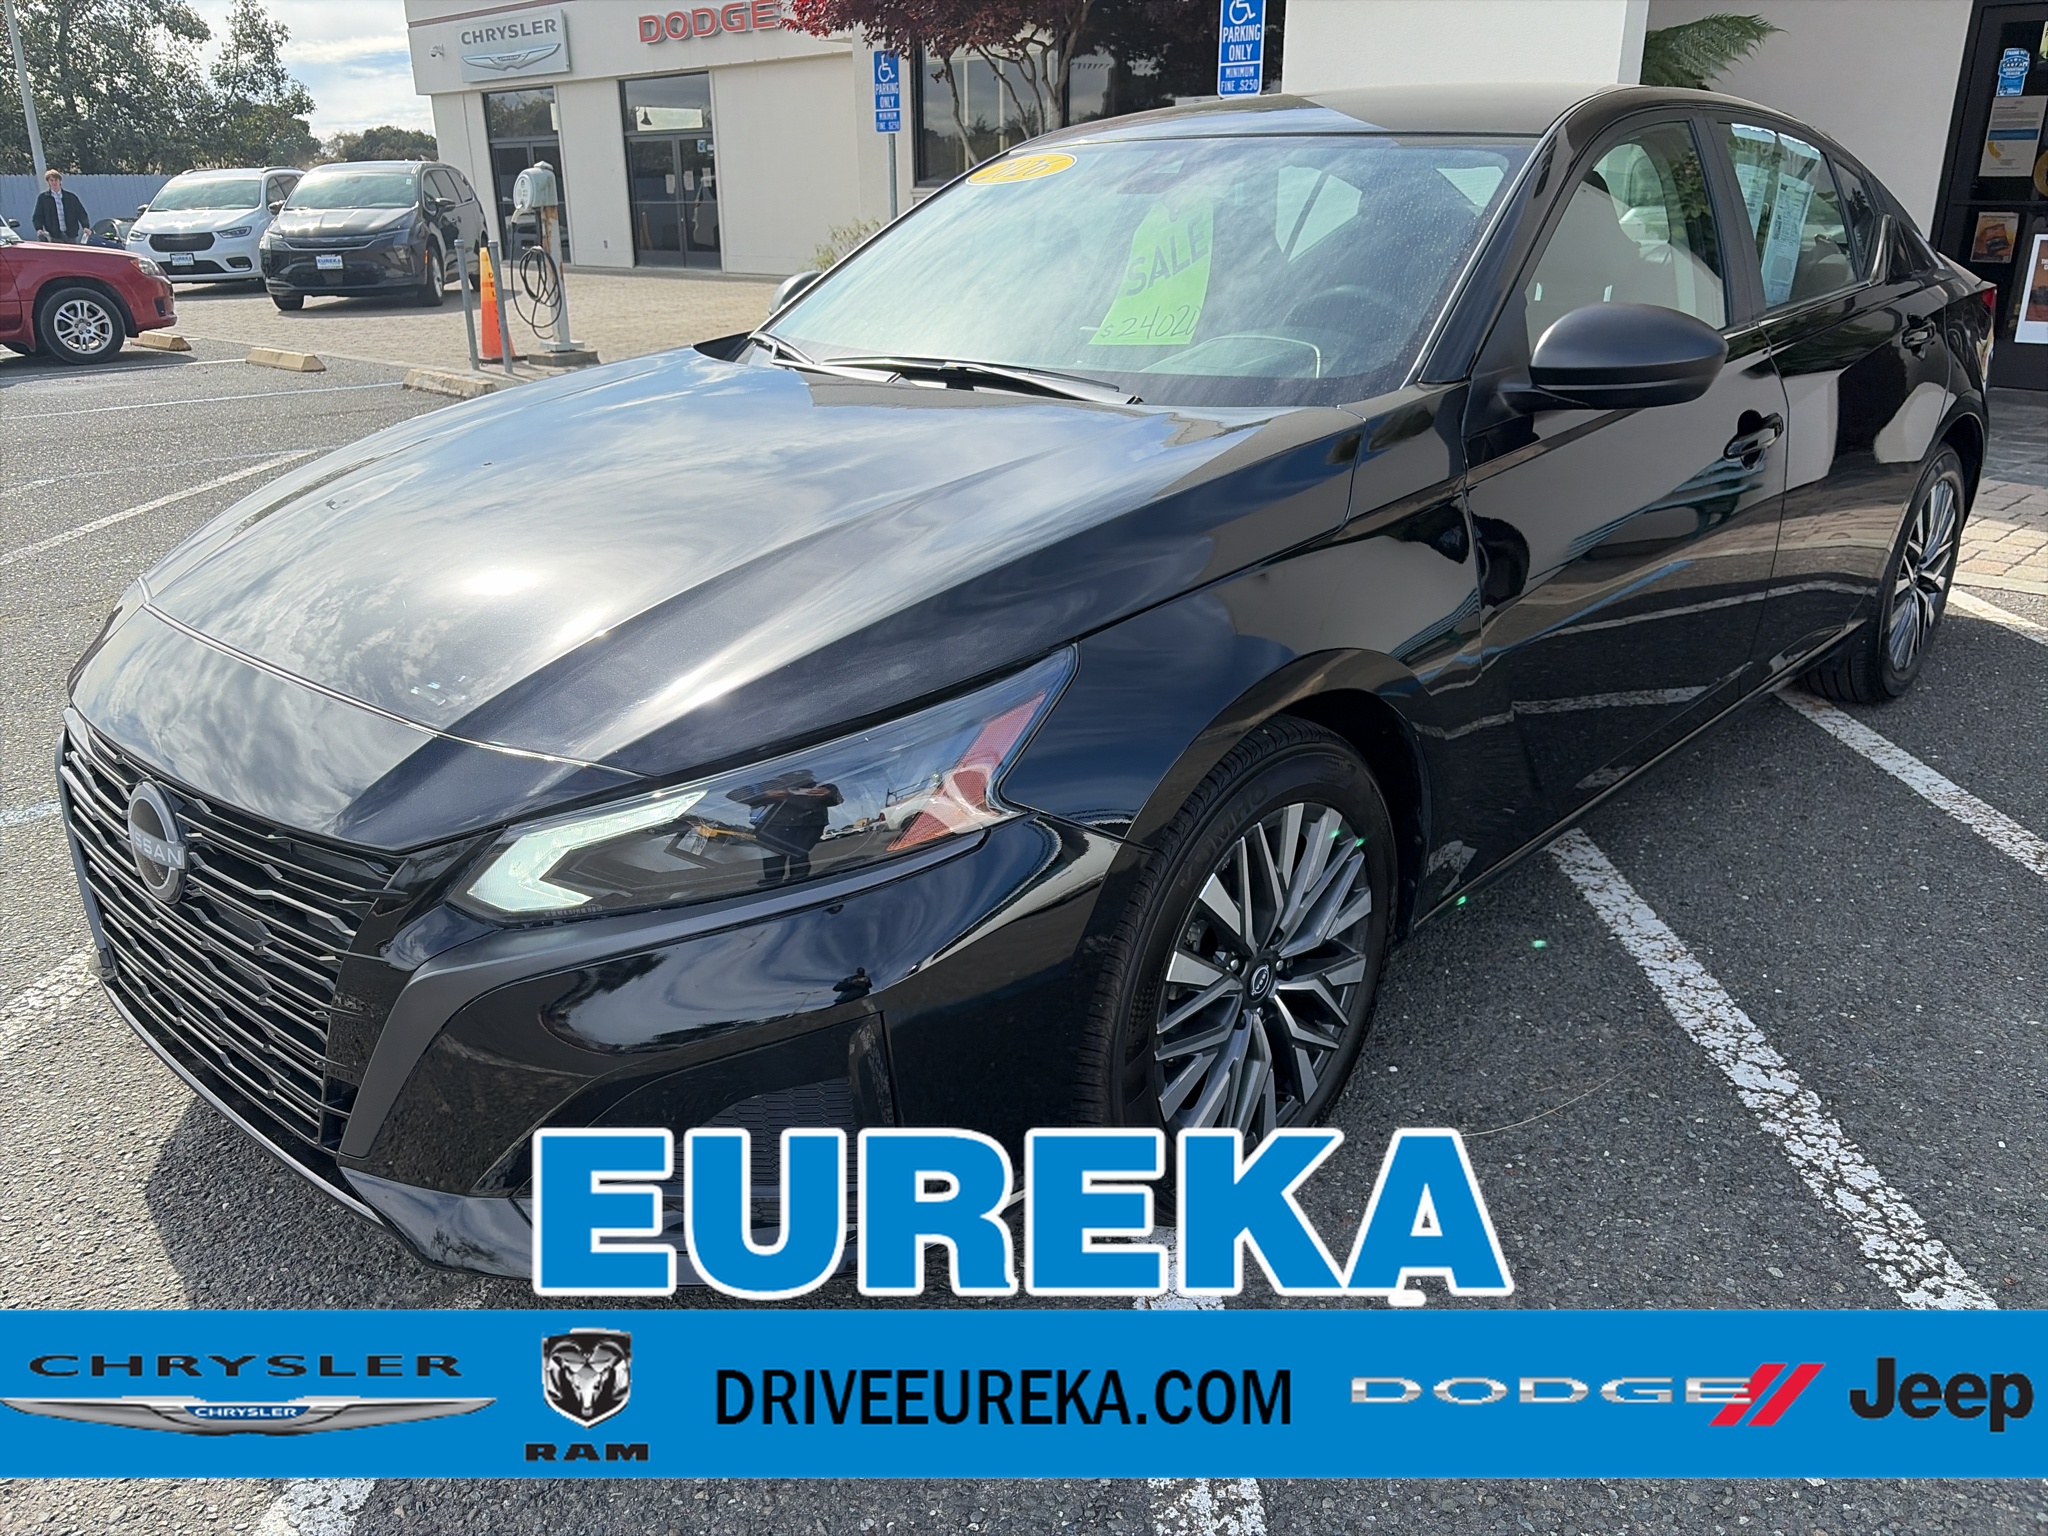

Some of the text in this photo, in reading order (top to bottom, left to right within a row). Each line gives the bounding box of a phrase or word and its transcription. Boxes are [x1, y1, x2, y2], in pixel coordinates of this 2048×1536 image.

[638, 0, 777, 44] DODGE
[461, 18, 557, 45] CHRYSLER
[1222, 24, 1261, 43] PARKING
[1228, 44, 1253, 61] ONLY
[1225, 66, 1255, 78] MINIMUM
[875, 82, 899, 95] PARKING
[1221, 79, 1259, 92] FINE $250
[880, 96, 895, 108] ONLY
[1125, 214, 1210, 297] SALE
[131, 830, 182, 866] SSAN
